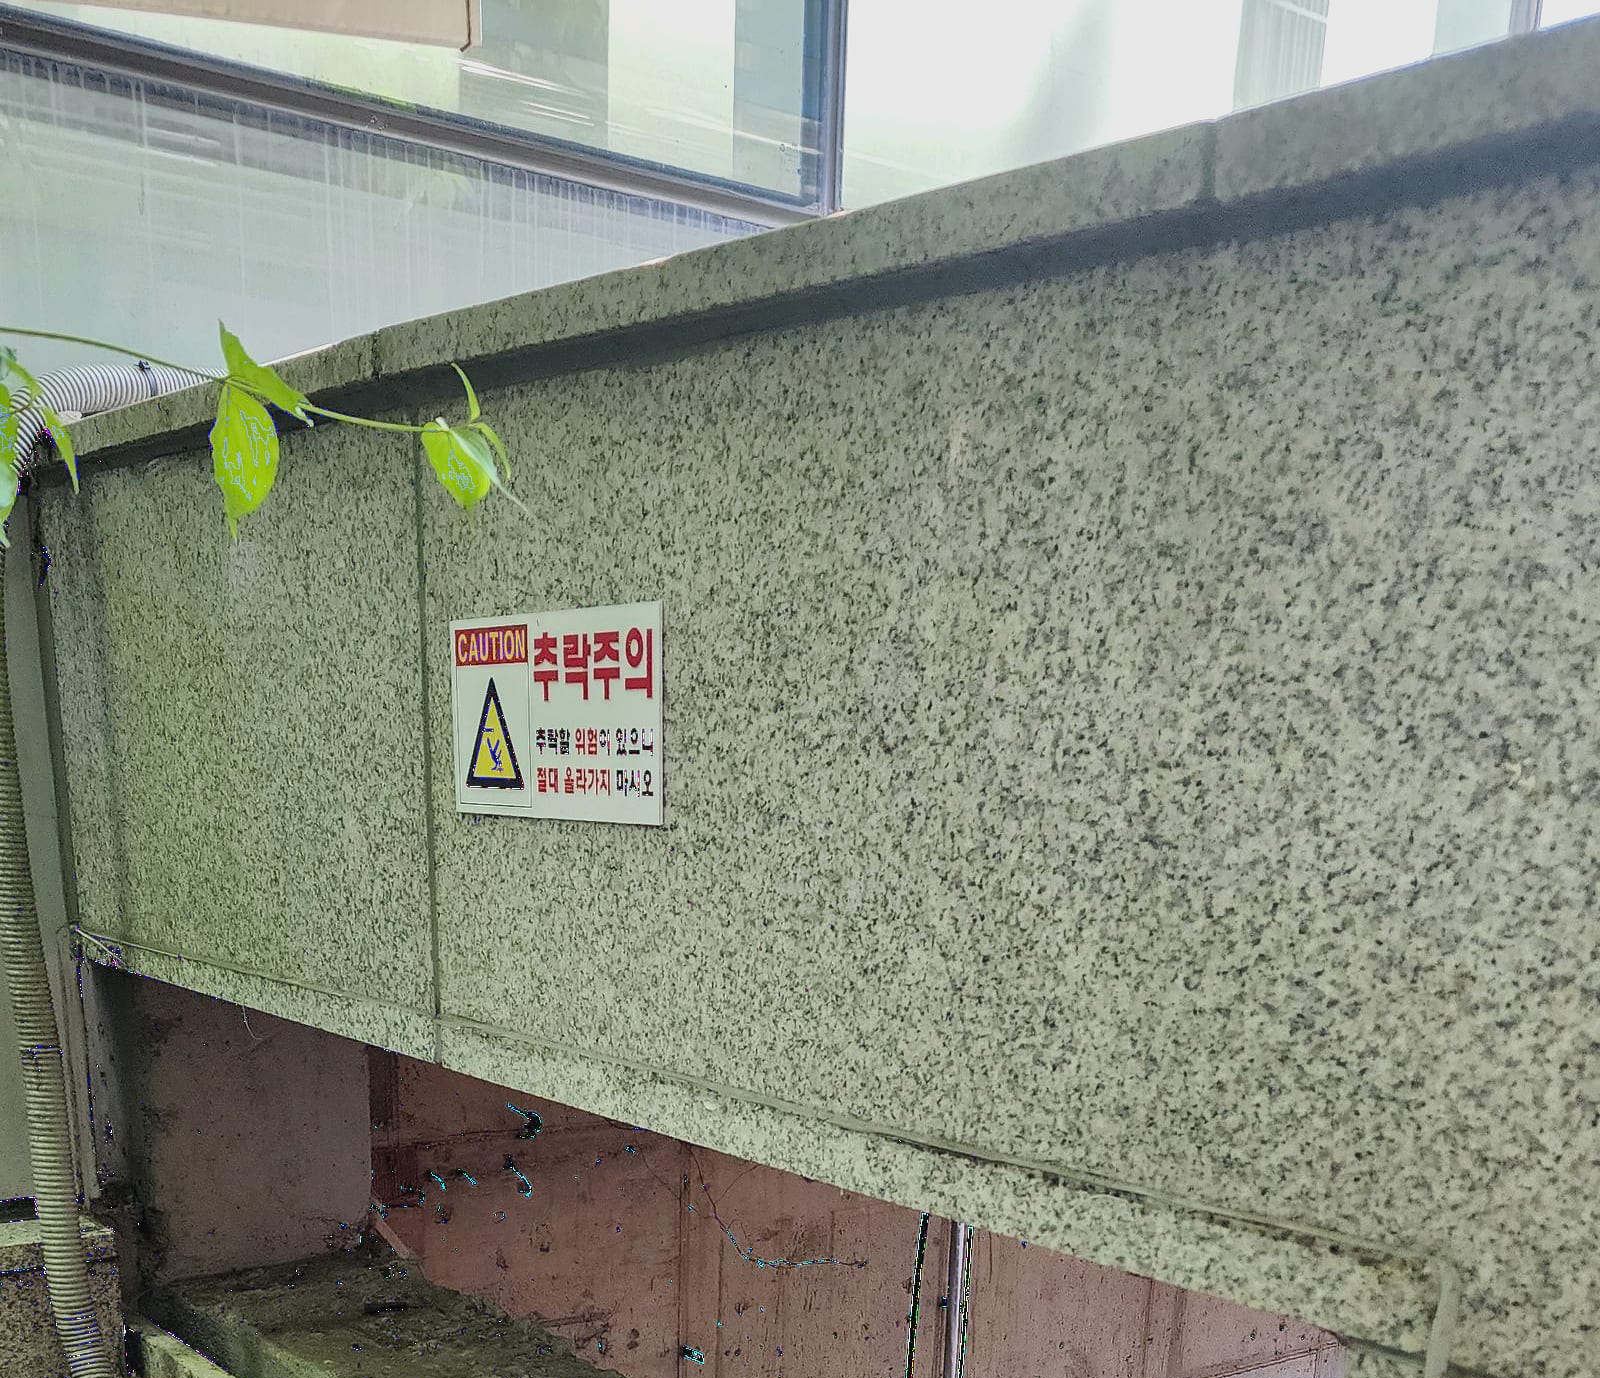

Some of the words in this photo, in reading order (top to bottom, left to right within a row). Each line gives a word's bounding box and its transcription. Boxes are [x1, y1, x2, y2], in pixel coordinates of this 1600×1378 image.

[457, 629, 526, 663] CAUTION
[533, 627, 653, 702] 추락주의
[535, 727, 571, 755] 추락할
[575, 728, 611, 756] 위험이
[615, 728, 654, 756] 있으니
[537, 767, 559, 793] 절대
[563, 766, 611, 796] 올라가지
[616, 769, 654, 797] 마시오
